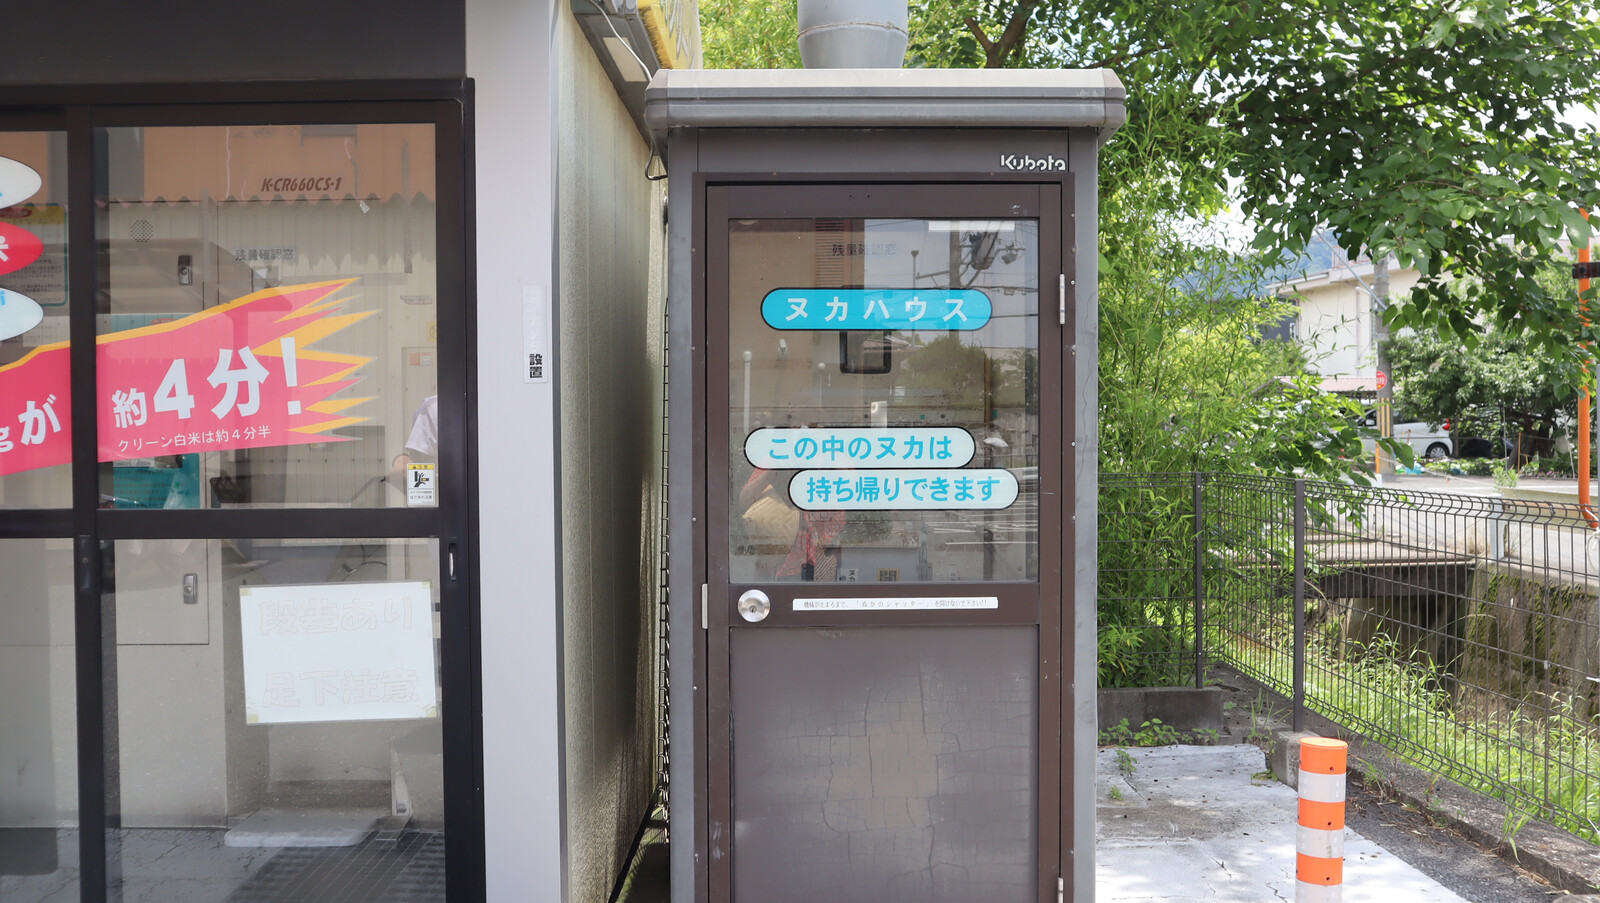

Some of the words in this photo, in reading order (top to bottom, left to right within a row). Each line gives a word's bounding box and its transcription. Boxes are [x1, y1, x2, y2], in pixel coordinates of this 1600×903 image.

[1000, 154, 1066, 171] Kubota
[261, 177, 342, 192] K-CR660CS-1
[235, 248, 294, 261] 残量確認窓
[832, 243, 897, 256] 残量確認窓
[785, 296, 968, 322] ヌカハウス
[768, 435, 953, 461] この中のヌカは
[806, 476, 1001, 503] 持ち帰りできます
[258, 596, 413, 637] 段差あり
[261, 668, 420, 709] 足下注意
